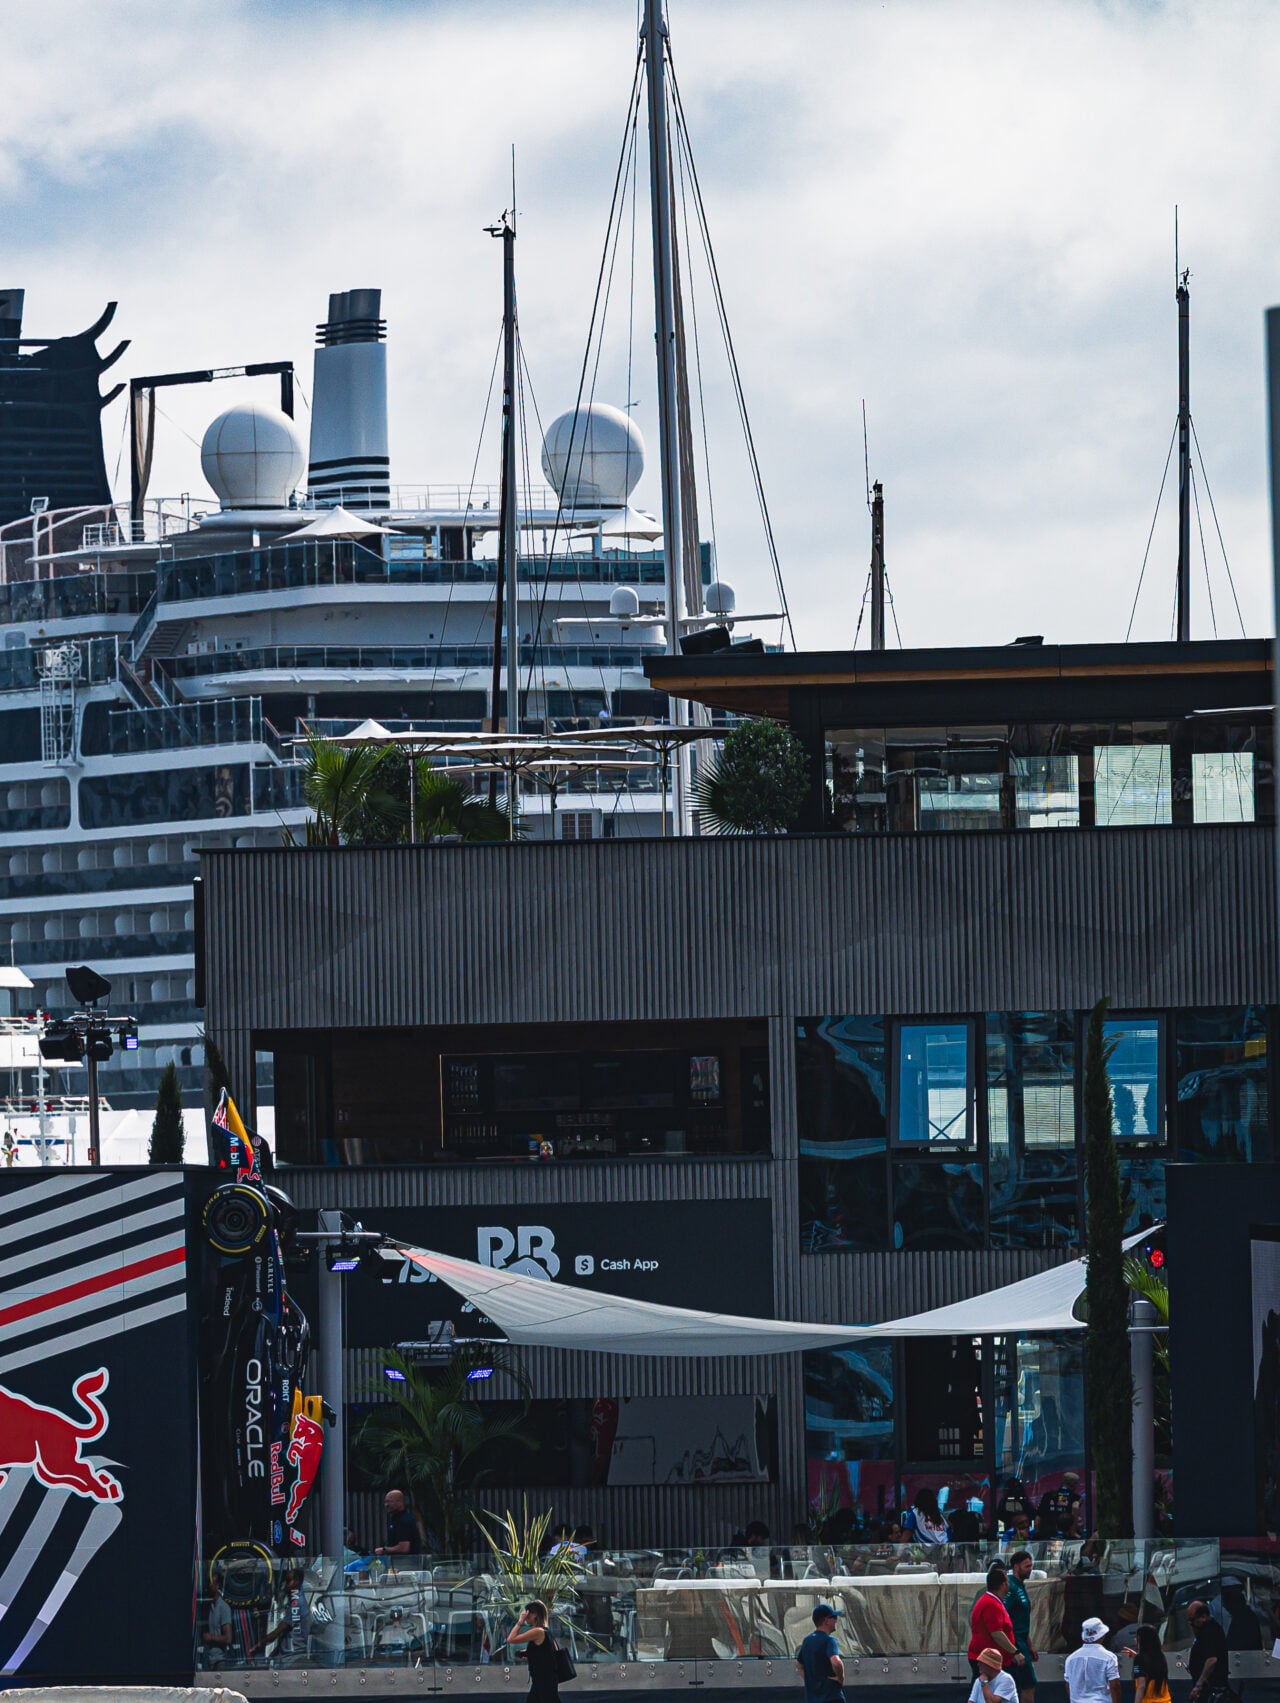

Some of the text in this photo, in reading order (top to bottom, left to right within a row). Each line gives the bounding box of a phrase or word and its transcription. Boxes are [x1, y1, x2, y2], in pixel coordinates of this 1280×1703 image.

[230, 1136, 240, 1165] Mobil
[382, 1256, 439, 1284] IS
[600, 1259, 631, 1271] Cash
[633, 1259, 660, 1272] App
[223, 1287, 234, 1316] indeed
[282, 1379, 290, 1402] ROKT
[246, 1358, 265, 1479] ORACLE
[271, 1440, 286, 1506] Red Bull
